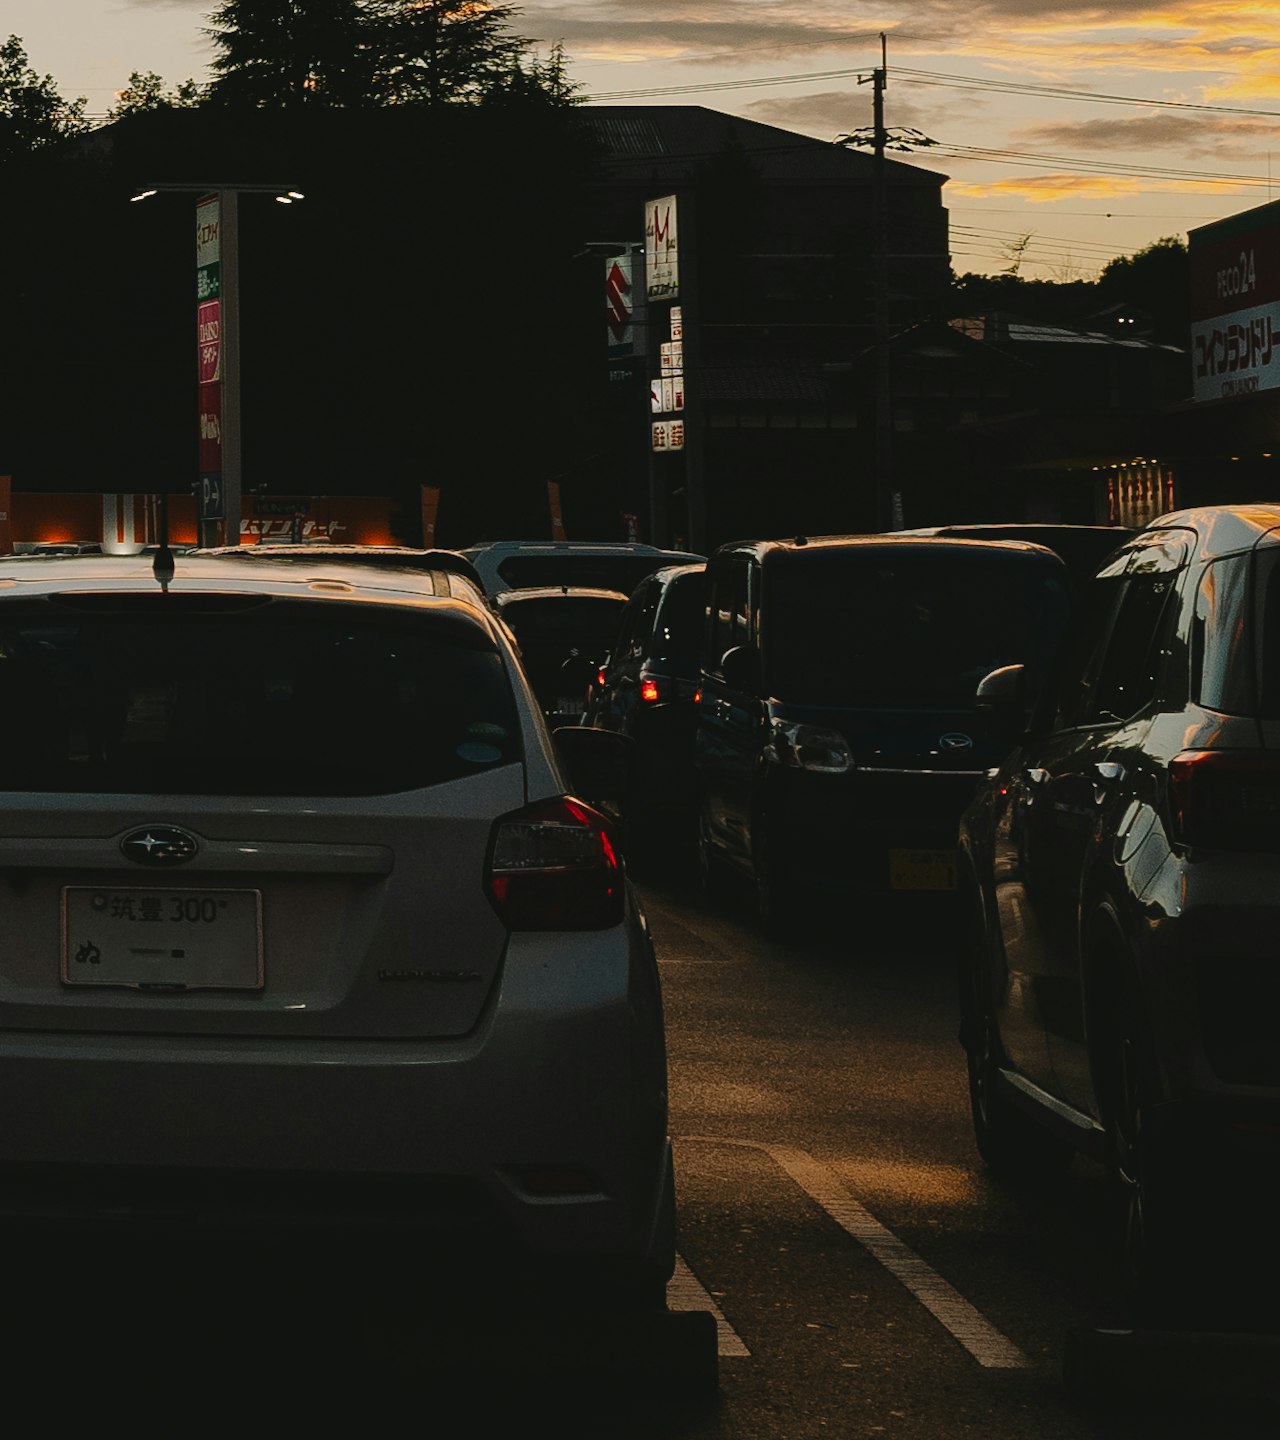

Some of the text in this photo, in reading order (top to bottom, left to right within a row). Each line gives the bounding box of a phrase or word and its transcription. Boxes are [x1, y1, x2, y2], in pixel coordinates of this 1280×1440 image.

[200, 321, 219, 342] DAISO
[1195, 316, 1280, 378] コインランドリー
[203, 478, 210, 516] P
[111, 897, 217, 923] 筑豊 300
[75, 939, 101, 964] ぬ
